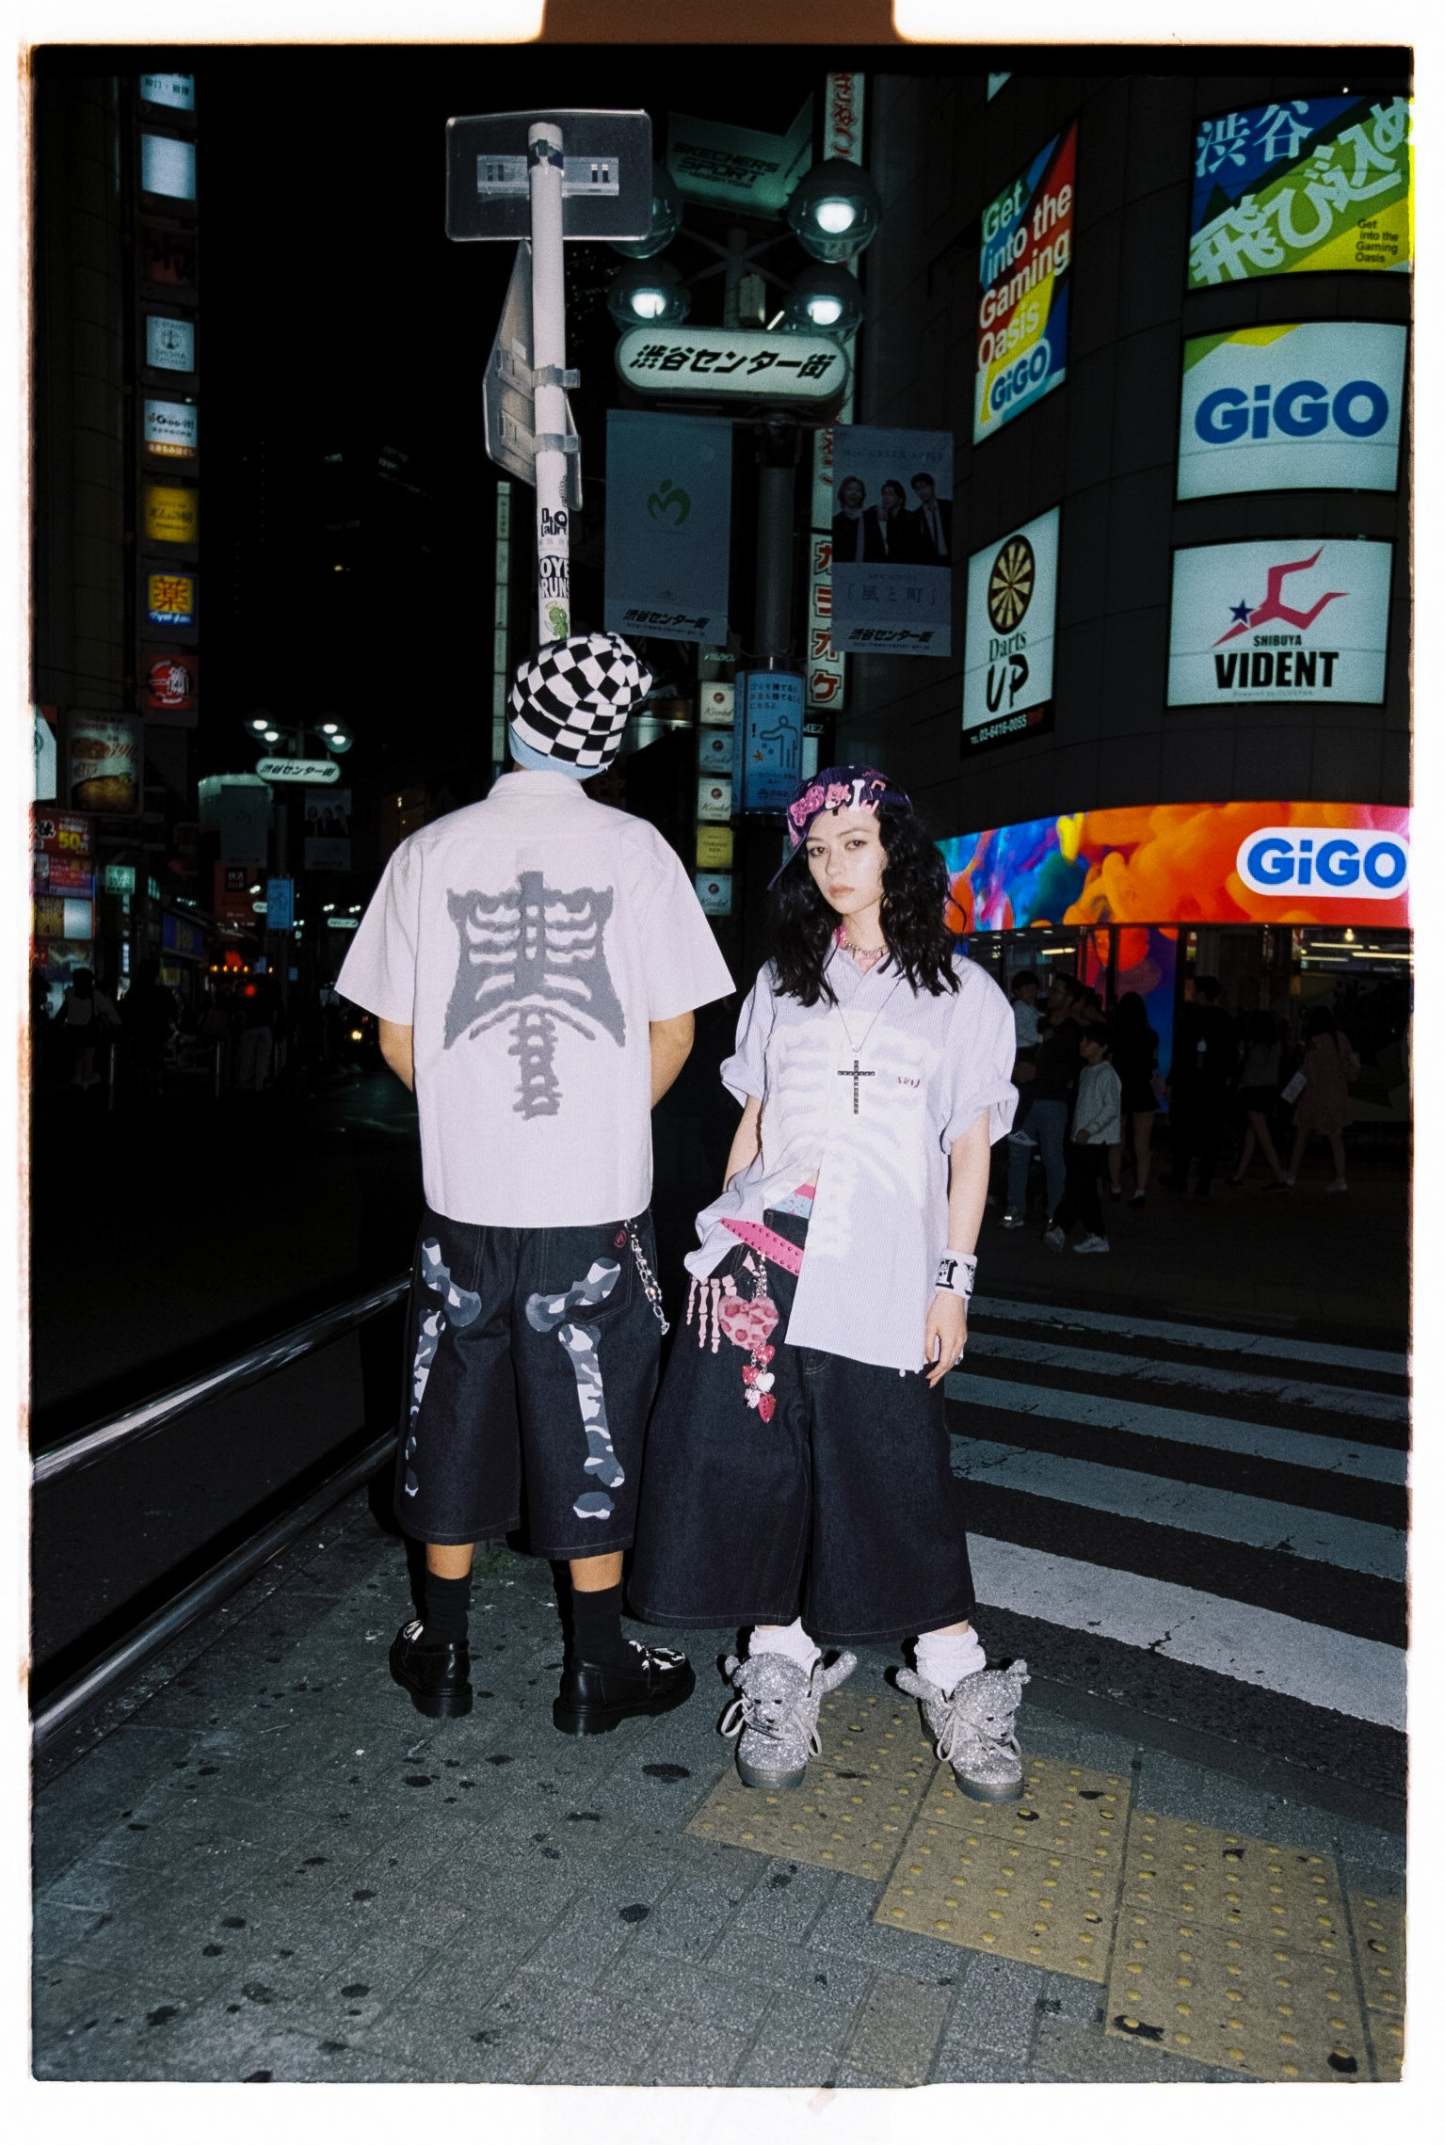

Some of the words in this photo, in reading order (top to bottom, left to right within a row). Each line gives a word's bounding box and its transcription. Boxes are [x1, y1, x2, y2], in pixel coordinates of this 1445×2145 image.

[672, 142, 780, 173] SKECHERS
[1195, 99, 1315, 178] 渋谷
[678, 160, 765, 183] SPORT
[1188, 97, 1413, 287] 飛び込め
[984, 191, 1022, 245] Get
[987, 232, 1025, 281] into
[1033, 184, 1072, 240] the
[1358, 218, 1377, 231] Get
[1360, 230, 1379, 242] into
[1382, 231, 1400, 243] the
[1356, 241, 1398, 255] Gaming
[1356, 251, 1386, 264] Oasis
[979, 238, 1071, 328] Gaming
[978, 300, 1040, 370] Oasis
[629, 343, 837, 379] 渋谷センター街
[991, 345, 1048, 411] GiGO
[1194, 378, 1390, 444] GiGO
[623, 608, 711, 629] 渋谷センター街
[848, 628, 935, 643] 渋谷センター街
[989, 632, 1028, 663] Darts
[1253, 634, 1303, 647] SHIBUYA
[986, 652, 1031, 713] UP
[1214, 650, 1340, 690] VIDENT
[1247, 836, 1408, 890] GiGO
